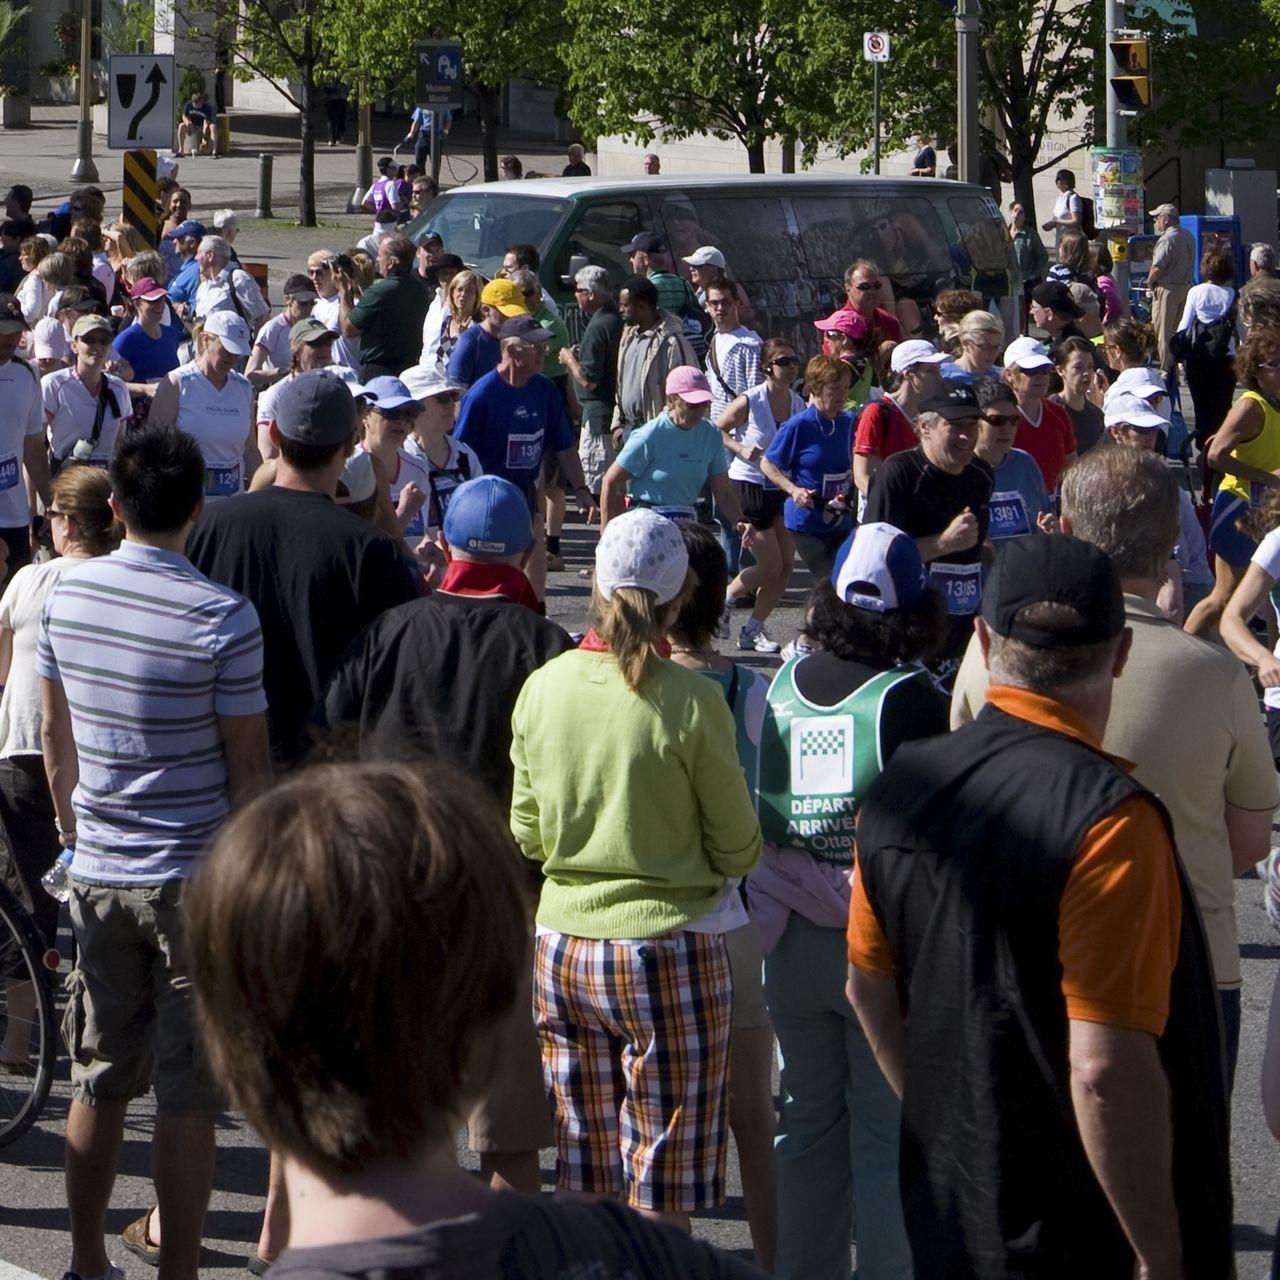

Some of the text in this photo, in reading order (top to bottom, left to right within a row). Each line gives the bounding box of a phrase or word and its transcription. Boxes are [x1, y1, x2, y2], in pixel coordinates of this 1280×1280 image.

[1046, 142, 1067, 152] ELGIN
[791, 796, 856, 815] DÉPART
[786, 815, 856, 836] ARRIVÉ
